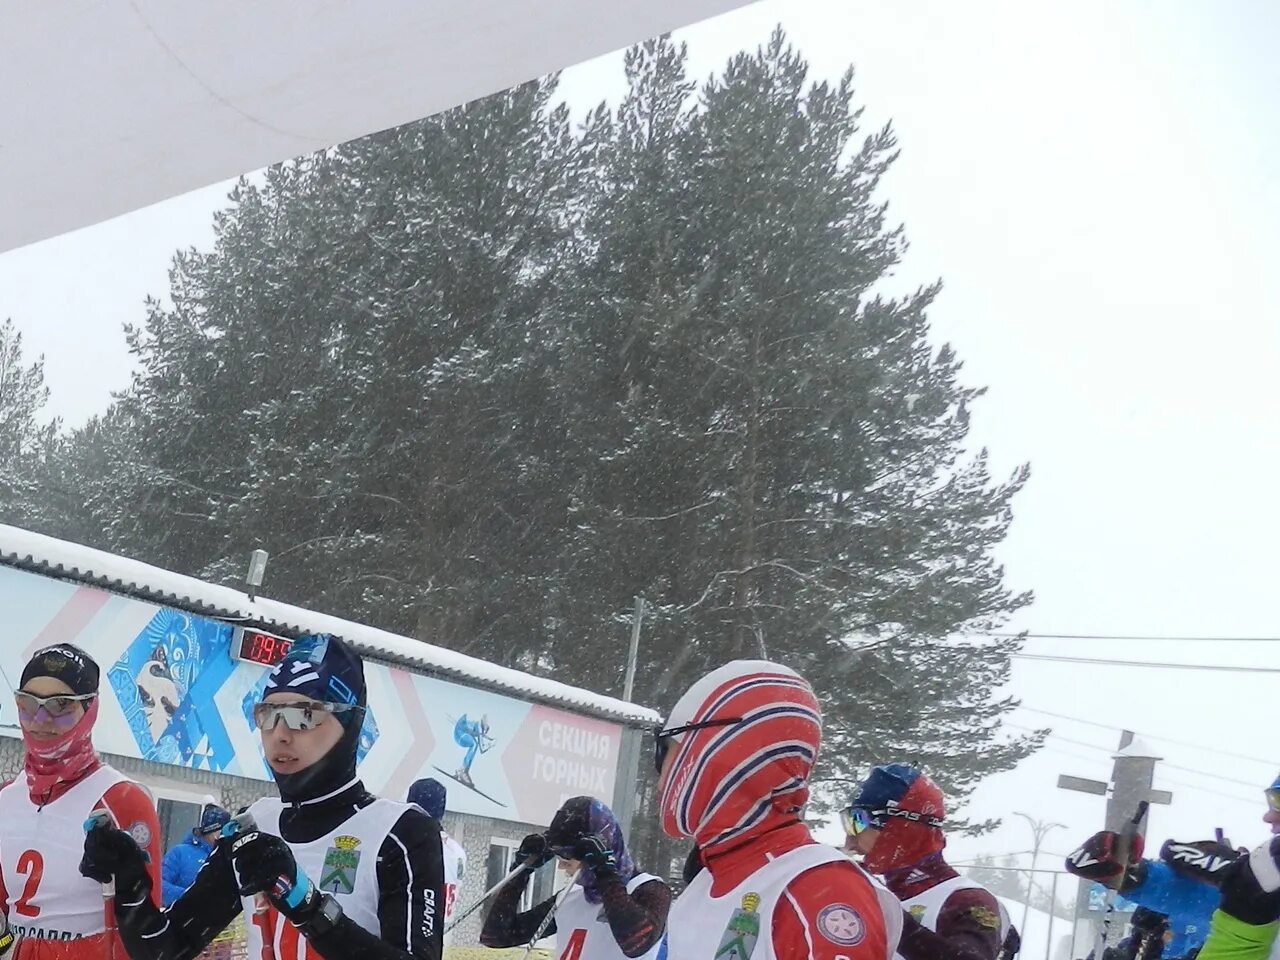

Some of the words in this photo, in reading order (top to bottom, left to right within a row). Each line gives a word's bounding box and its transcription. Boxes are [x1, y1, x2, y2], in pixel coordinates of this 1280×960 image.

[539, 720, 611, 760] СЕКЦИЯ
[532, 753, 608, 794] ГОРНЫХ
[15, 849, 44, 918] 2
[423, 888, 435, 931] CRAFT
